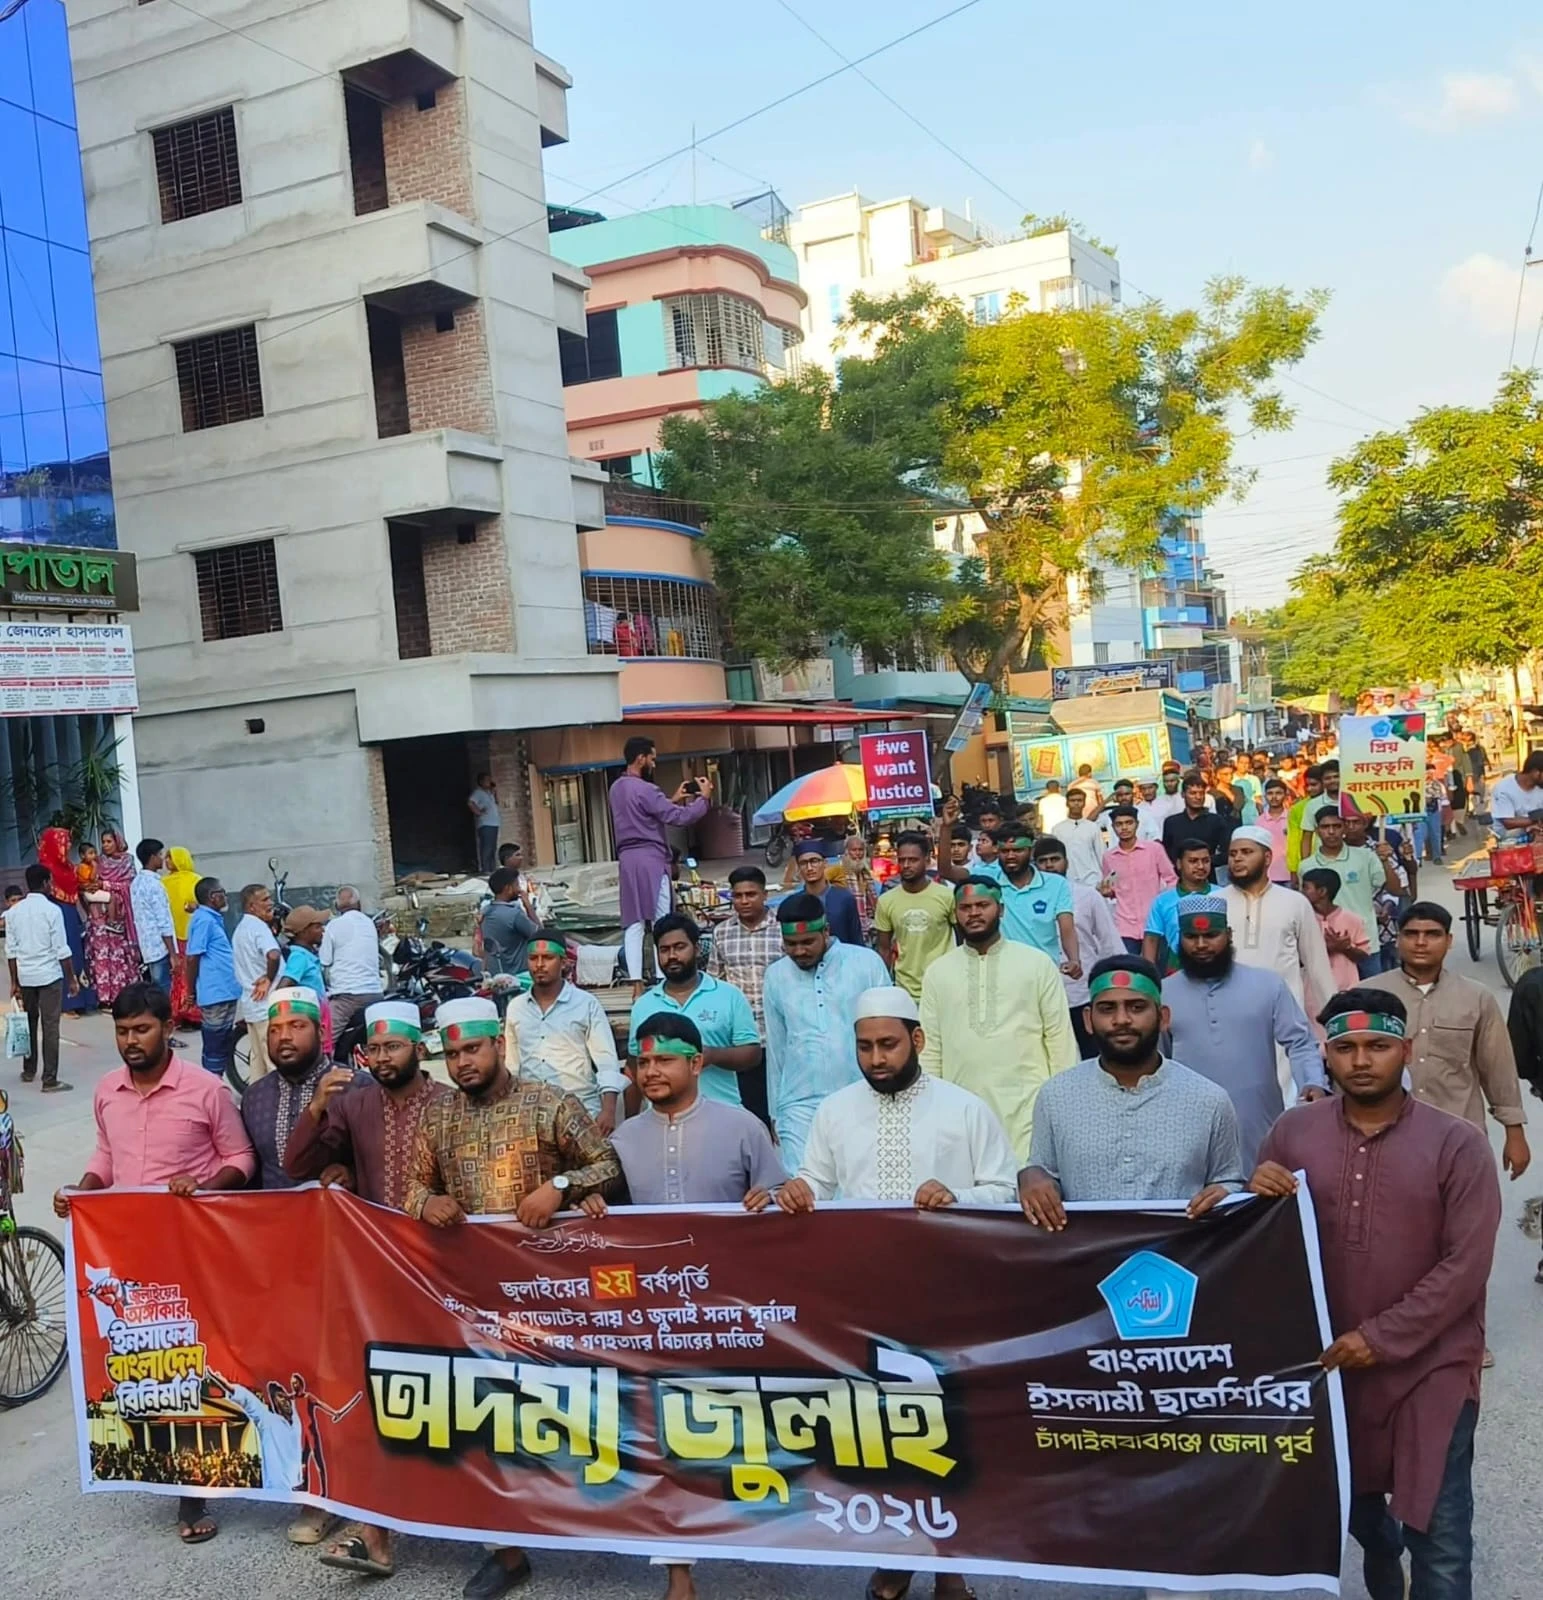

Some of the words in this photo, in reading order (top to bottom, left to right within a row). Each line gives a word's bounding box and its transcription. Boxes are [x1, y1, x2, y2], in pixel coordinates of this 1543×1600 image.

[0, 546, 119, 594] পাতাল
[6, 625, 61, 637] জেনারেল
[64, 626, 124, 638] হাসপাতাল
[875, 740, 910, 755] #we
[1370, 738, 1399, 753] প্রিয়
[874, 759, 917, 777] want
[1353, 756, 1414, 776] মাতৃভূমি
[869, 782, 924, 801] Justice
[1346, 779, 1421, 793] বাংলাদেশ
[499, 1276, 590, 1304] জুলাইয়ের
[595, 1269, 634, 1297] ২য়
[638, 1264, 709, 1299] বর্ষপূর্তি
[507, 1307, 587, 1328] গণভোটের
[591, 1309, 623, 1329] রায়
[628, 1311, 643, 1327] ও
[646, 1301, 699, 1331] জুলাই
[702, 1305, 744, 1323] সনদ
[109, 1320, 197, 1354] ইনসাফের
[580, 1333, 653, 1351] গণহত্যার
[658, 1328, 713, 1350] বিচারের
[716, 1326, 765, 1350] দাবিতে
[108, 1345, 205, 1381] বাংলাদেশ
[1086, 1343, 1233, 1374] বাংলাদেশ
[1026, 1380, 1146, 1413] ইসলামী
[1149, 1374, 1313, 1416] ছাত্রশিবির
[368, 1348, 620, 1484] অদম্য
[656, 1346, 958, 1503] জুলাই
[1034, 1426, 1203, 1454] চাঁপাইনবাবগঞ্জ
[1209, 1432, 1268, 1454] জেলা
[1273, 1427, 1315, 1464] পূর্ব
[814, 1490, 958, 1538] ২০২৬
